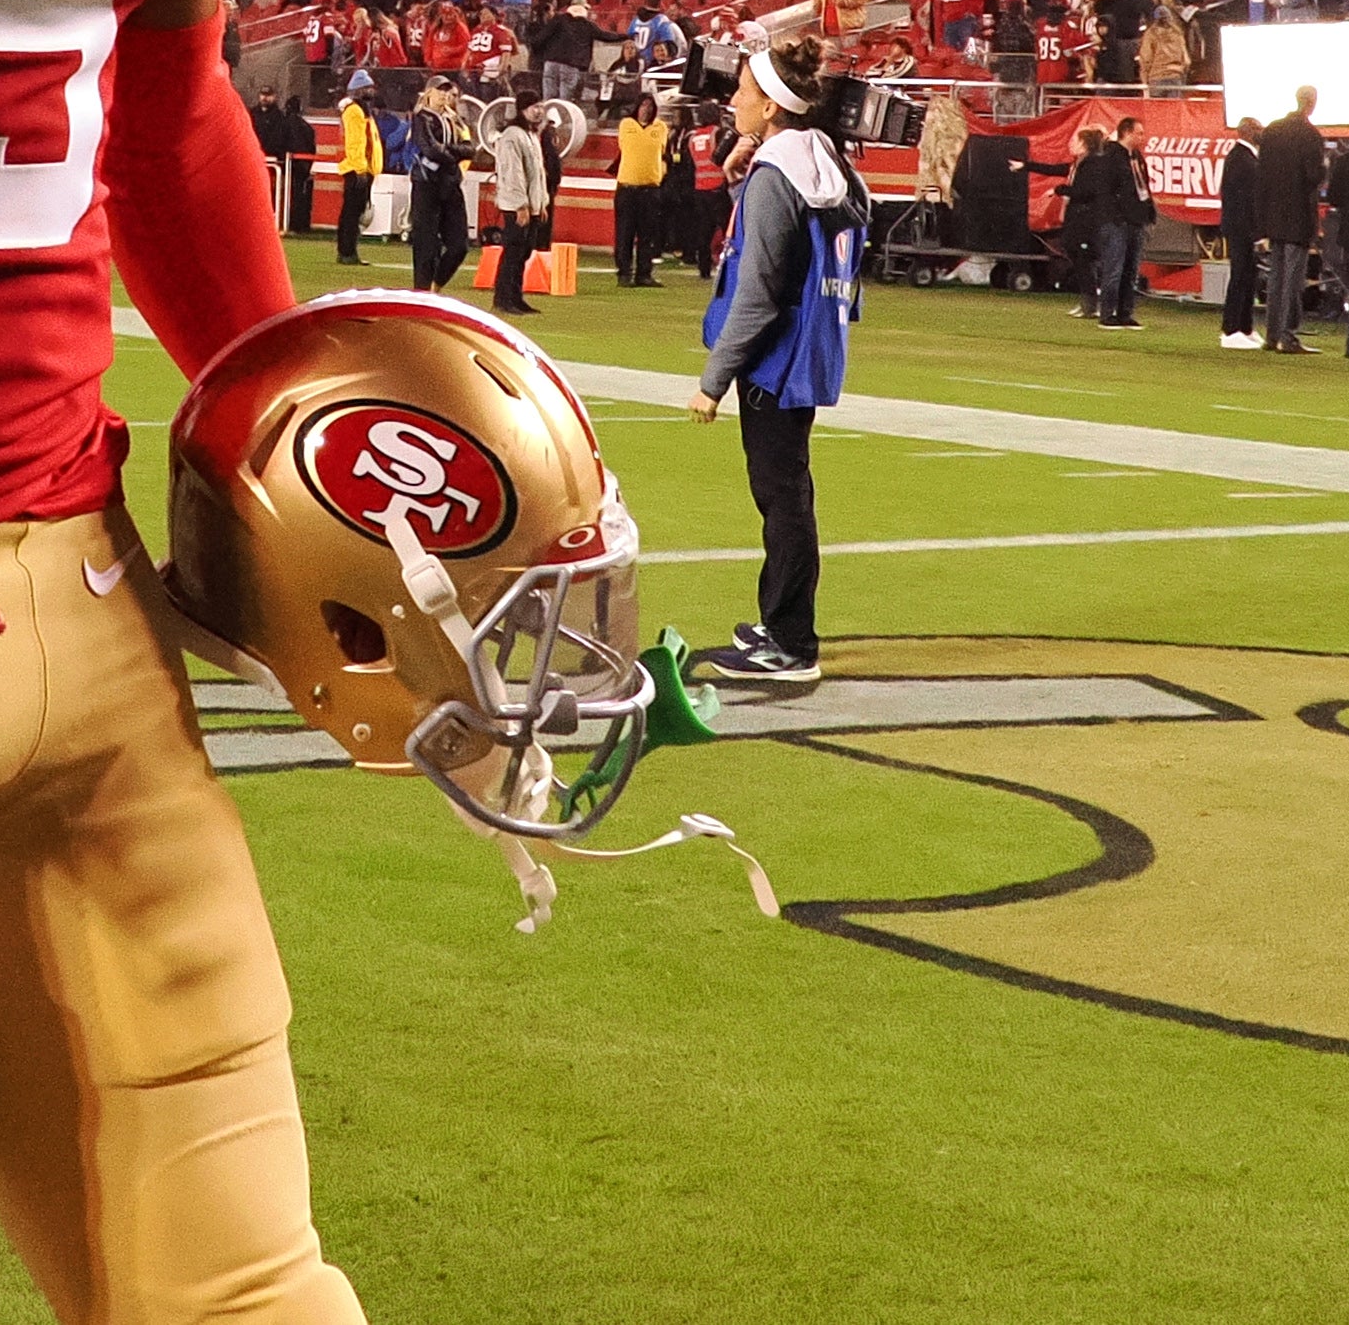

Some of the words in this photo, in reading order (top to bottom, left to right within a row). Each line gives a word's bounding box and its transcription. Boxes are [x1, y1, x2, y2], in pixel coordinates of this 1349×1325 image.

[468, 33, 493, 52] 29
[1038, 37, 1062, 61] 85
[1144, 136, 1211, 155] SALUTE
[1213, 138, 1237, 156] TO
[1145, 155, 1225, 196] SERV
